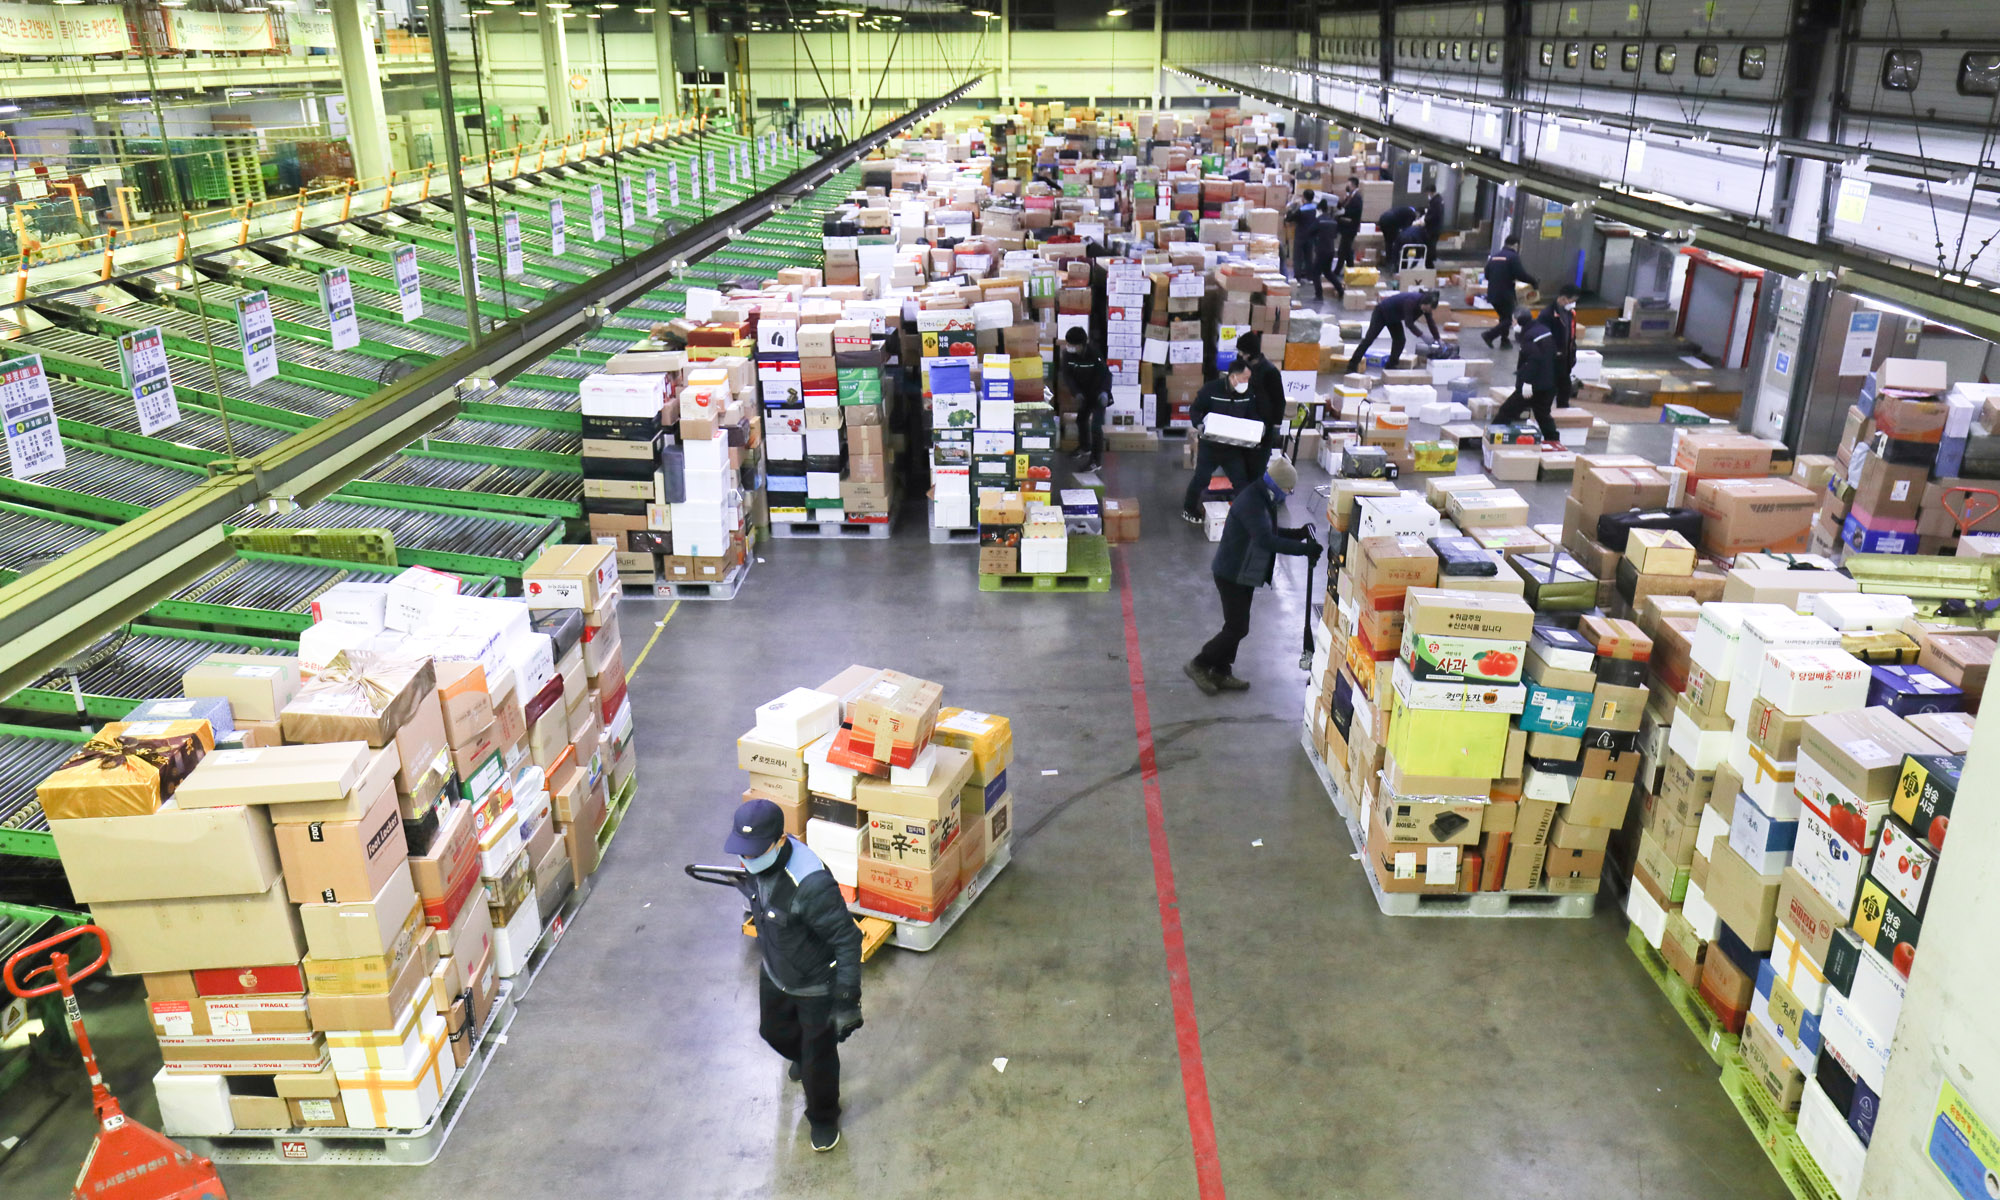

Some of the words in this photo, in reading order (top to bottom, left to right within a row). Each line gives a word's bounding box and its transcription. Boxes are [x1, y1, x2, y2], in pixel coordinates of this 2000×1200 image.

[1454, 613, 1482, 622] 취급주의
[1453, 622, 1480, 631] 신선식품
[1482, 624, 1502, 633] 입니다
[1435, 657, 1468, 674] 사과
[1798, 672, 1834, 681] 당일배송
[1836, 671, 1861, 681] 식품!!
[758, 755, 788, 768] 로켓프레시
[1923, 783, 1939, 802] 청송
[1919, 800, 1935, 818] 사과
[879, 822, 894, 831] 농심
[907, 825, 925, 835] 멀티팩
[367, 835, 381, 856] Foot
[380, 813, 400, 843] Locker
[891, 833, 912, 859] 辛
[912, 847, 926, 855] 라면
[871, 874, 891, 885] 우체국
[893, 879, 913, 892] 소포
[1885, 908, 1902, 930] 청송
[1880, 922, 1898, 943] 사과
[105, 1114, 124, 1127] 13
